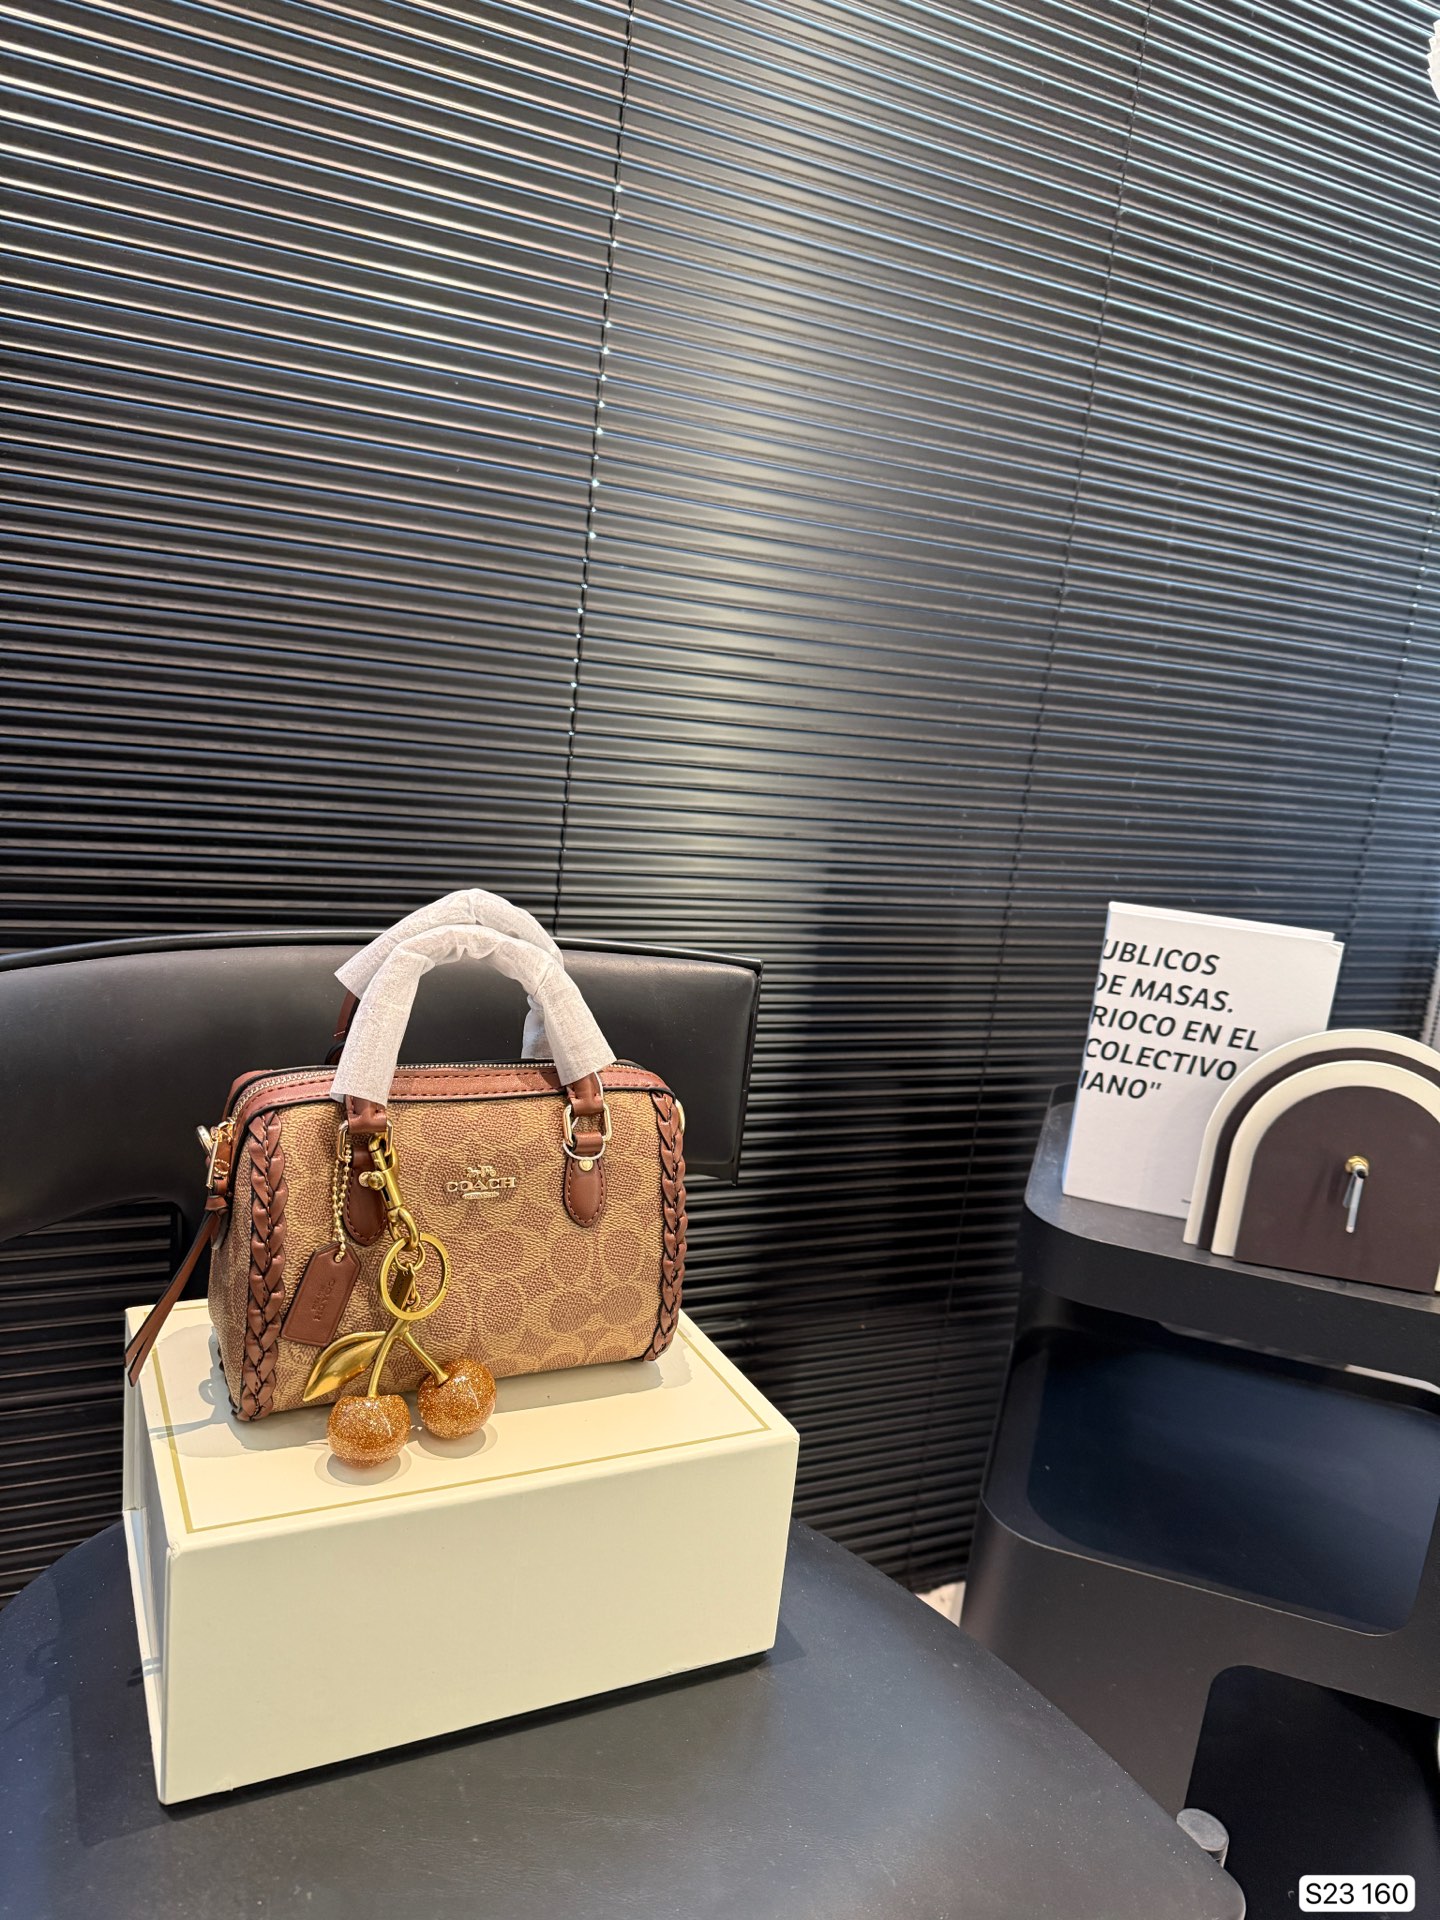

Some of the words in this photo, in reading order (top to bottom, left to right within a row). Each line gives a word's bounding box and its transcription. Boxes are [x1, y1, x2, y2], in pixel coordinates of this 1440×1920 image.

[1103, 939, 1220, 976] UBLICOS
[1130, 978, 1234, 1014] MASAS.
[1091, 1005, 1176, 1037] RIOCO
[1182, 1020, 1221, 1045] EN
[1227, 1028, 1260, 1052] EL
[1085, 1038, 1238, 1081] COLECTIVO
[444, 1177, 517, 1193] COACH
